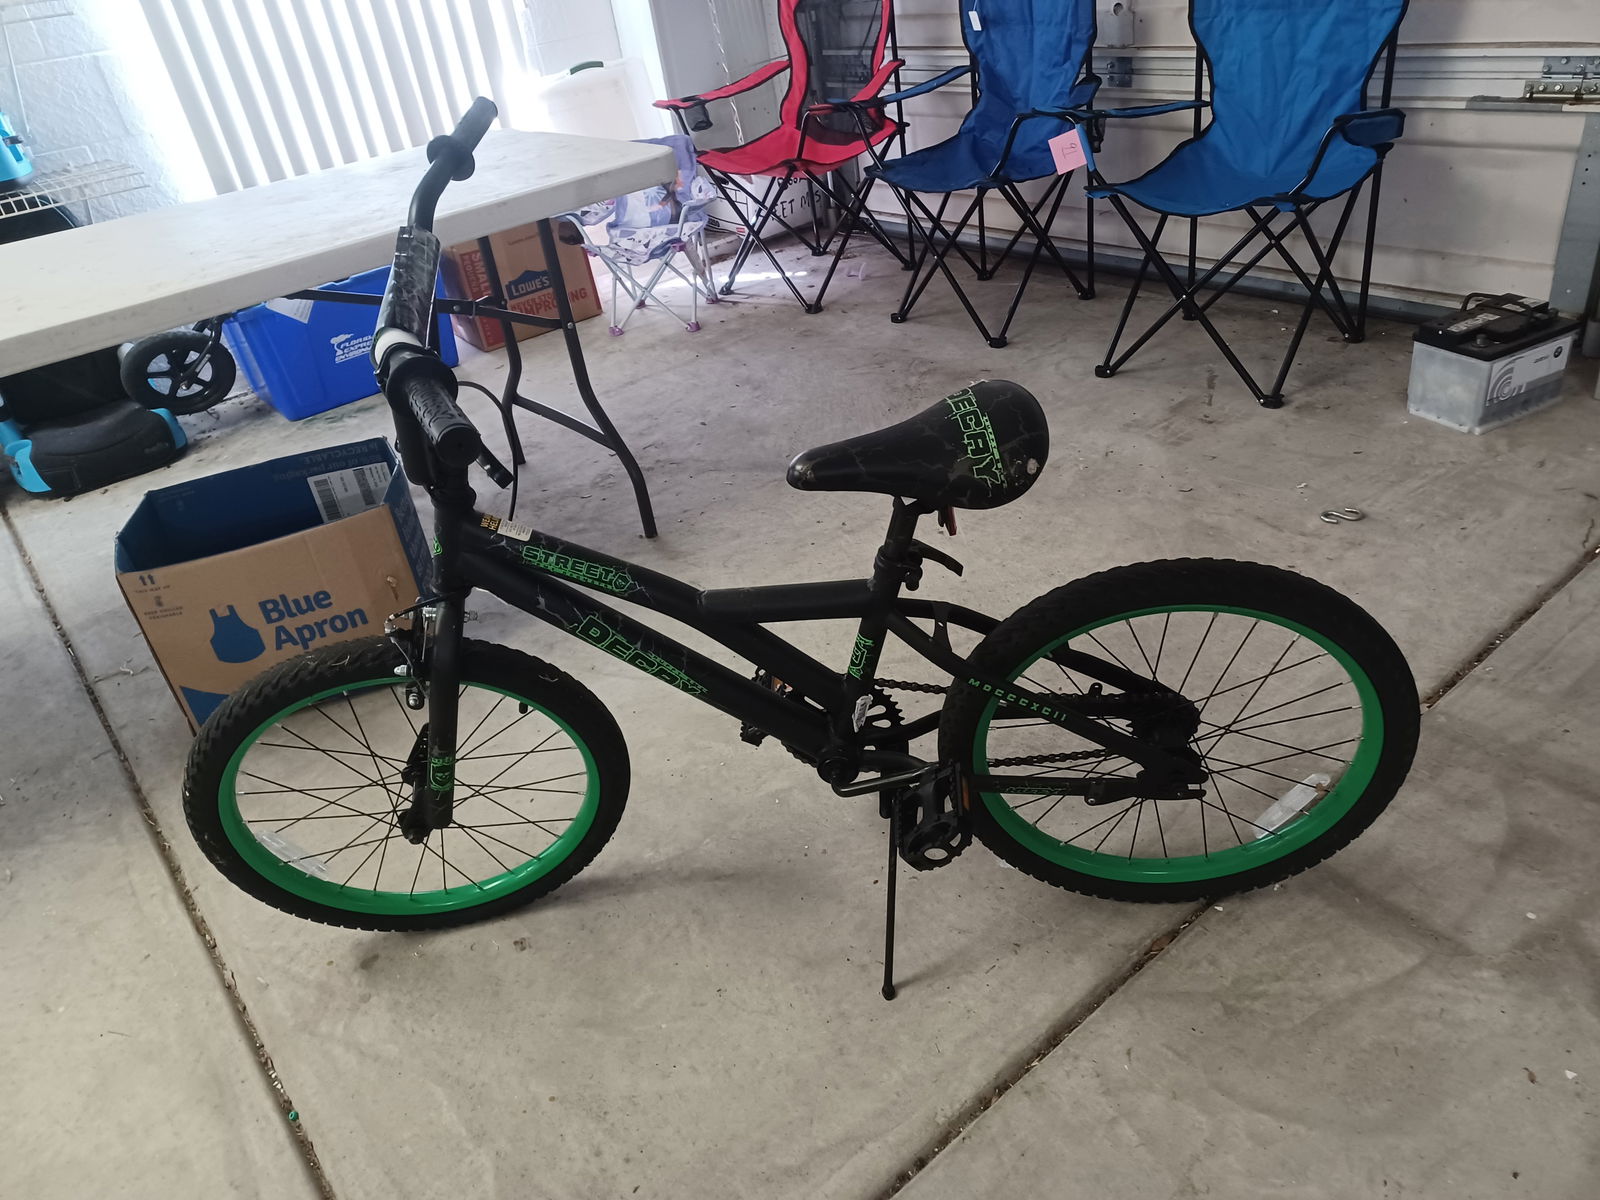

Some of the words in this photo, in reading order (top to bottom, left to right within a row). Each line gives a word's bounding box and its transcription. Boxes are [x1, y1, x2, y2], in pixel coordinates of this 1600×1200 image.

[511, 275, 551, 297] LOWE'S
[522, 545, 617, 583] STREET
[258, 589, 334, 625] Blue
[274, 607, 369, 650] Apron
[967, 678, 1067, 721] MDCCCXCII
